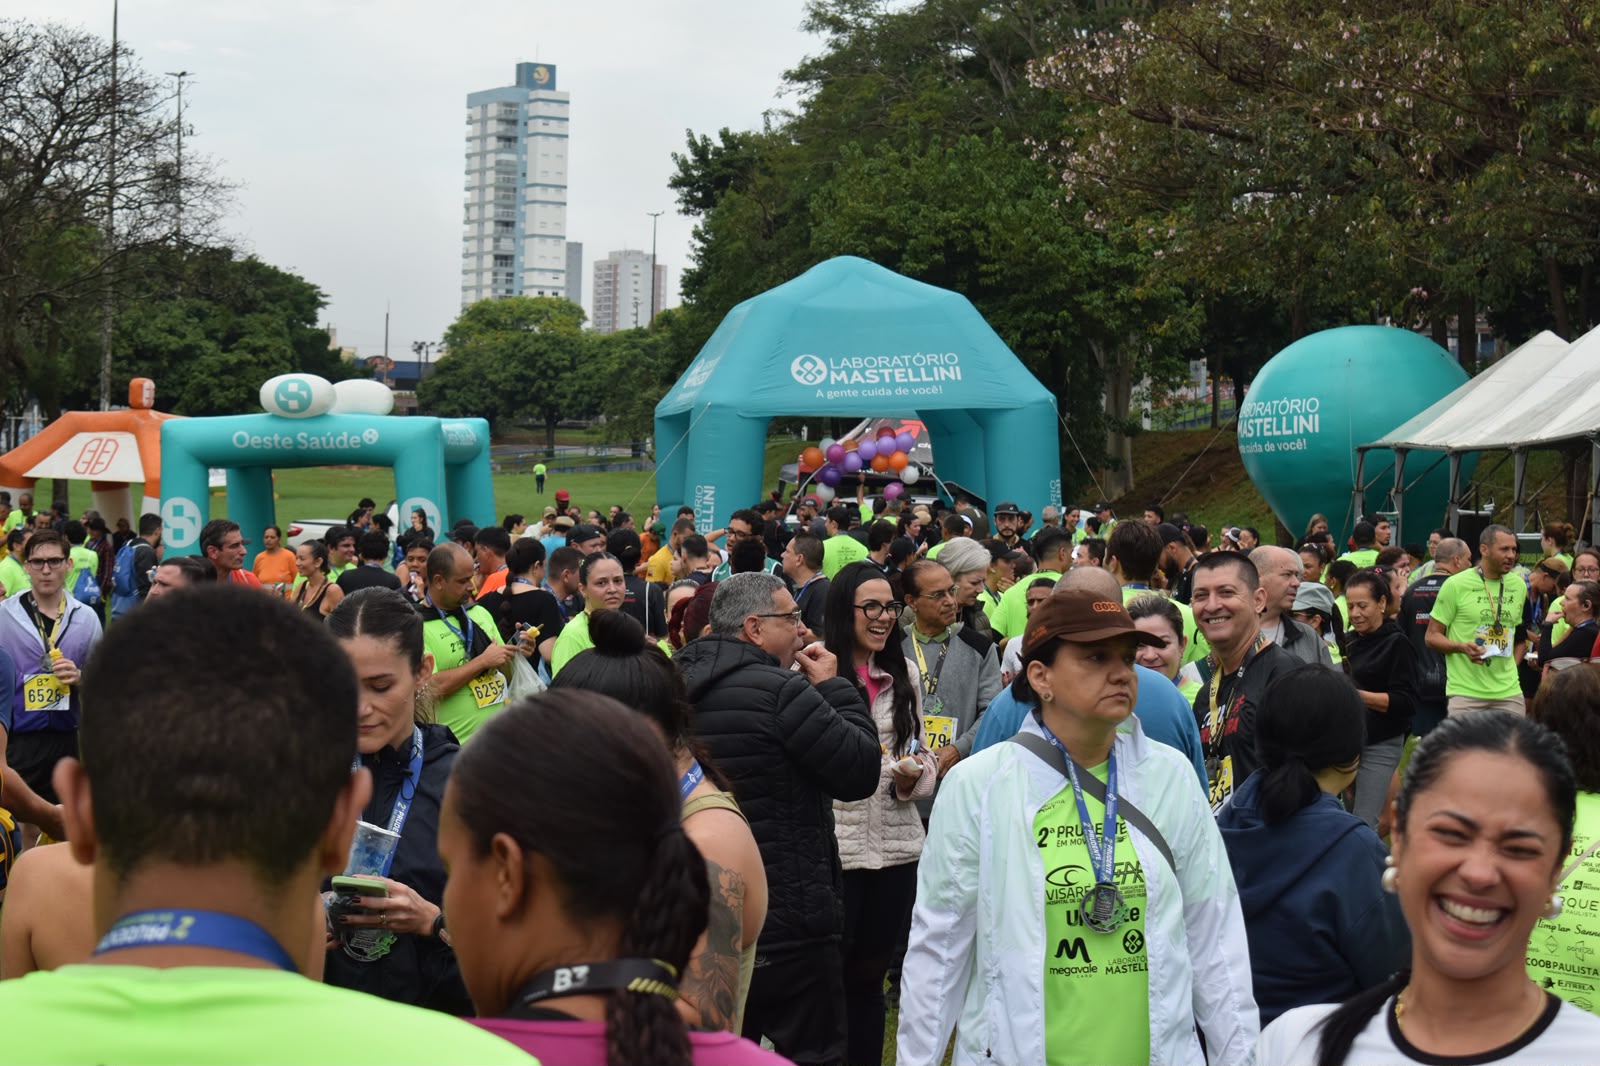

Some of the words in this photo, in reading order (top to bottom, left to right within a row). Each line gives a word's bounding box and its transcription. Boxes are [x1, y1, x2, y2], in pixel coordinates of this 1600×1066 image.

[829, 352, 959, 369] LABORATÓRIO
[830, 366, 962, 385] MASTELLINI
[816, 389, 824, 398] A
[827, 389, 859, 399] gente
[862, 386, 892, 396] cuida
[895, 386, 909, 395] de
[912, 385, 943, 395] você!
[1239, 397, 1319, 418] LABORATÓRIO
[1238, 414, 1319, 438] MASTELLINI
[232, 431, 293, 449] Oeste
[297, 431, 361, 449] Saúde
[1264, 441, 1275, 452] de
[1277, 438, 1307, 451] você!
[701, 485, 715, 535] ELLINI
[925, 732, 947, 749] 79
[1037, 827, 1056, 849] 2ª
[1057, 822, 1128, 838] PRUETE
[1057, 839, 1068, 848] EM
[1049, 964, 1098, 977] megavale
